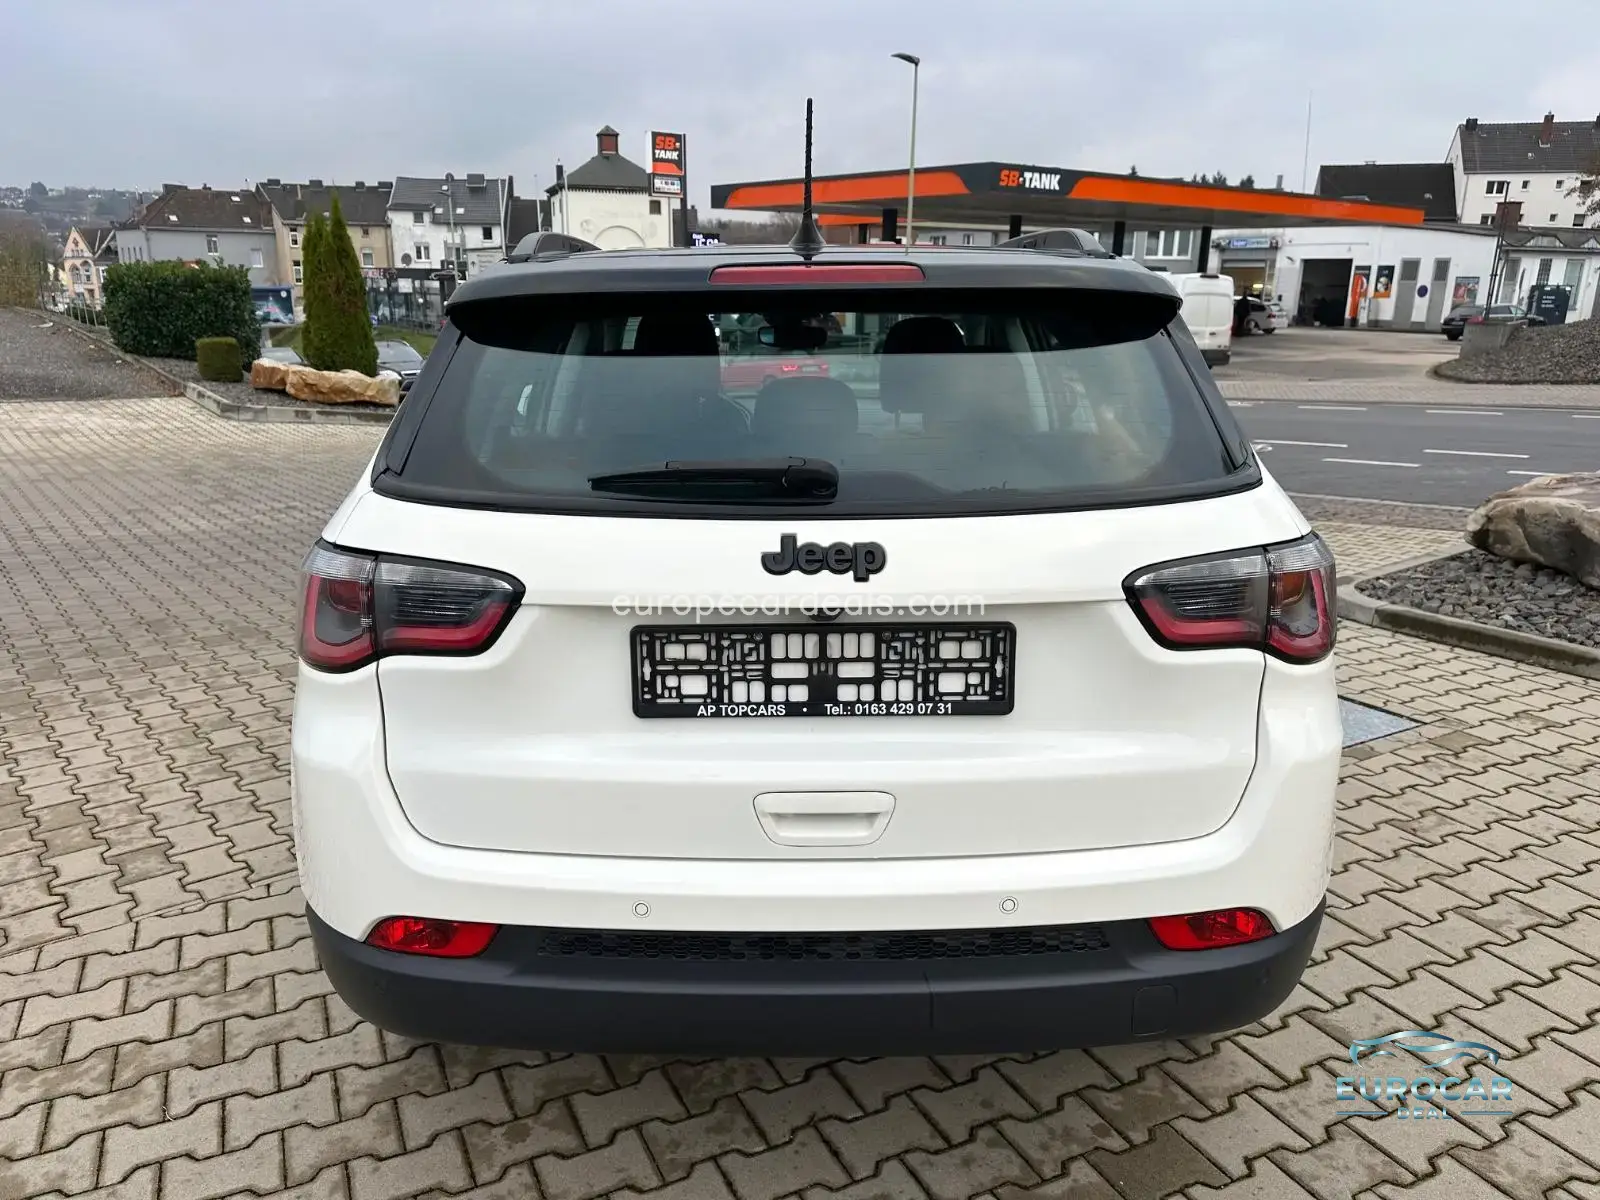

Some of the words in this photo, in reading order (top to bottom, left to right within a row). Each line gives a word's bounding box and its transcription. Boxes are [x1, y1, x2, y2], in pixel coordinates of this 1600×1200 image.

[655, 149, 679, 160] TANK
[761, 532, 887, 583] Jeep
[697, 705, 716, 717] AP
[720, 704, 786, 716] TOPCARS
[824, 703, 851, 716] Tel.:
[854, 703, 886, 715] 0163
[889, 703, 914, 715] 429
[917, 703, 933, 714] 07
[936, 702, 952, 714] 31
